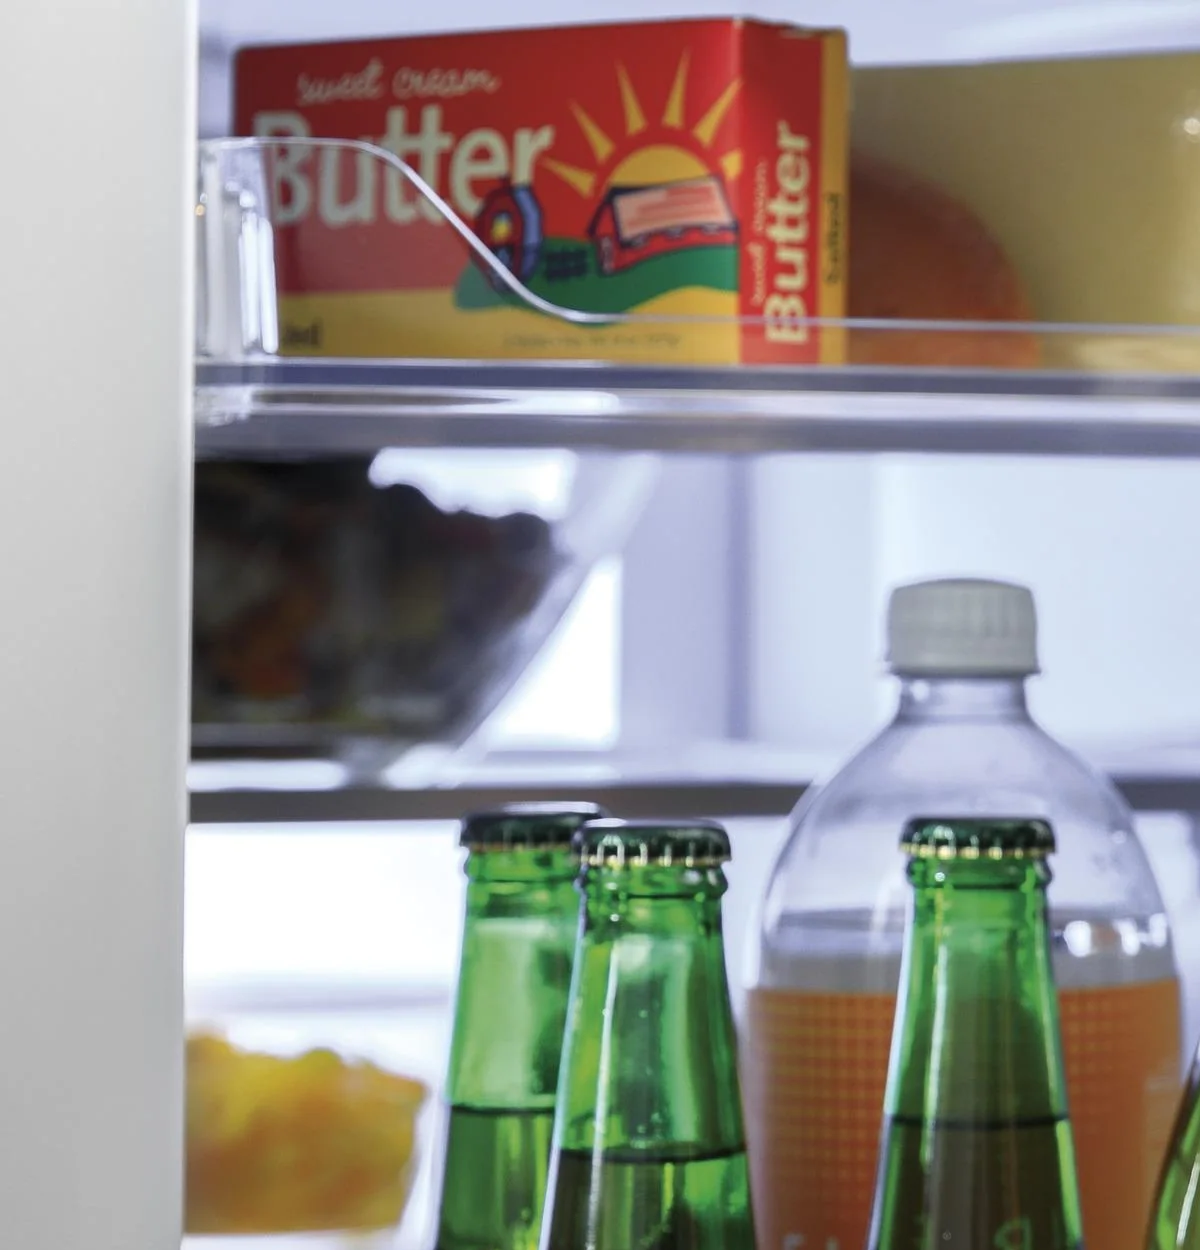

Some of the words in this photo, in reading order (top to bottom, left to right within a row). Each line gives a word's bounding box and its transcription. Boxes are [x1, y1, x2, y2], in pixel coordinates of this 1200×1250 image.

[297, 57, 383, 105] sweet
[393, 67, 500, 98] cream
[253, 103, 555, 229] Butter
[764, 120, 811, 343] Butter
